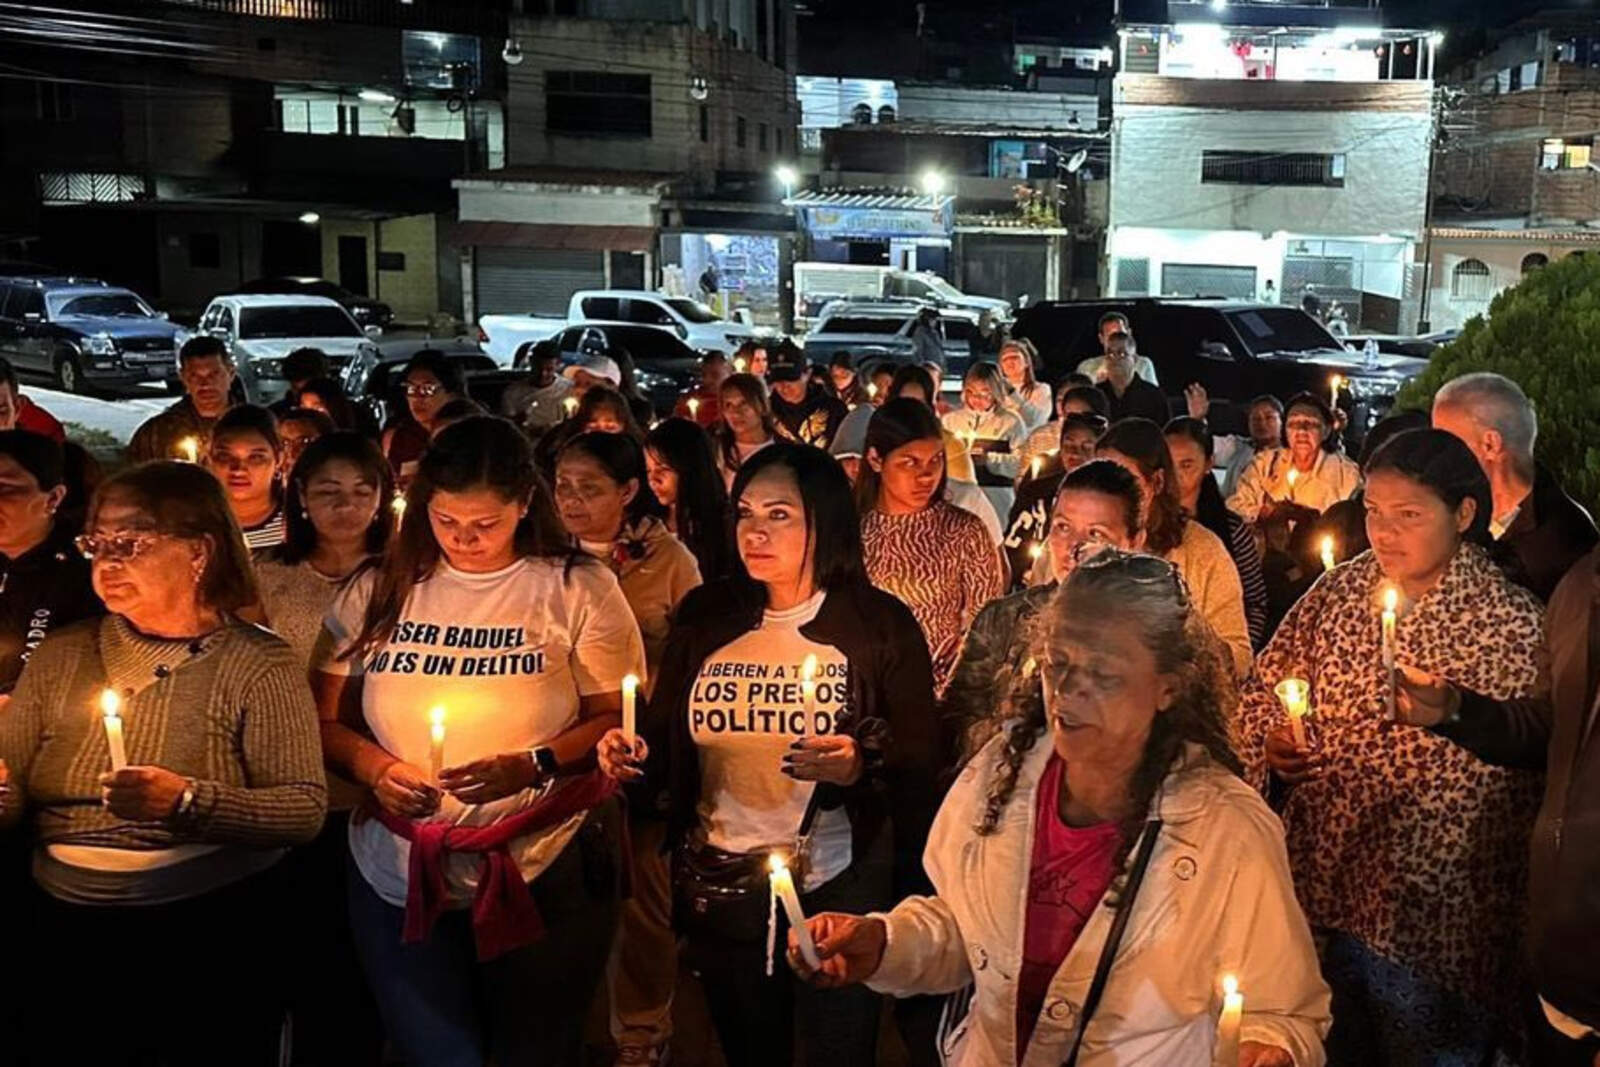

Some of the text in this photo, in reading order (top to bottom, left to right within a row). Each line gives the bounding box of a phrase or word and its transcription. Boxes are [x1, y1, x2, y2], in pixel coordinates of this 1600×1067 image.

[443, 626, 525, 648] BADUEL
[390, 652, 419, 674] ES
[422, 654, 456, 675] UN
[460, 653, 545, 676] DELITO!
[699, 662, 848, 679] LIBEREN A TDOS
[694, 681, 738, 703] LOS
